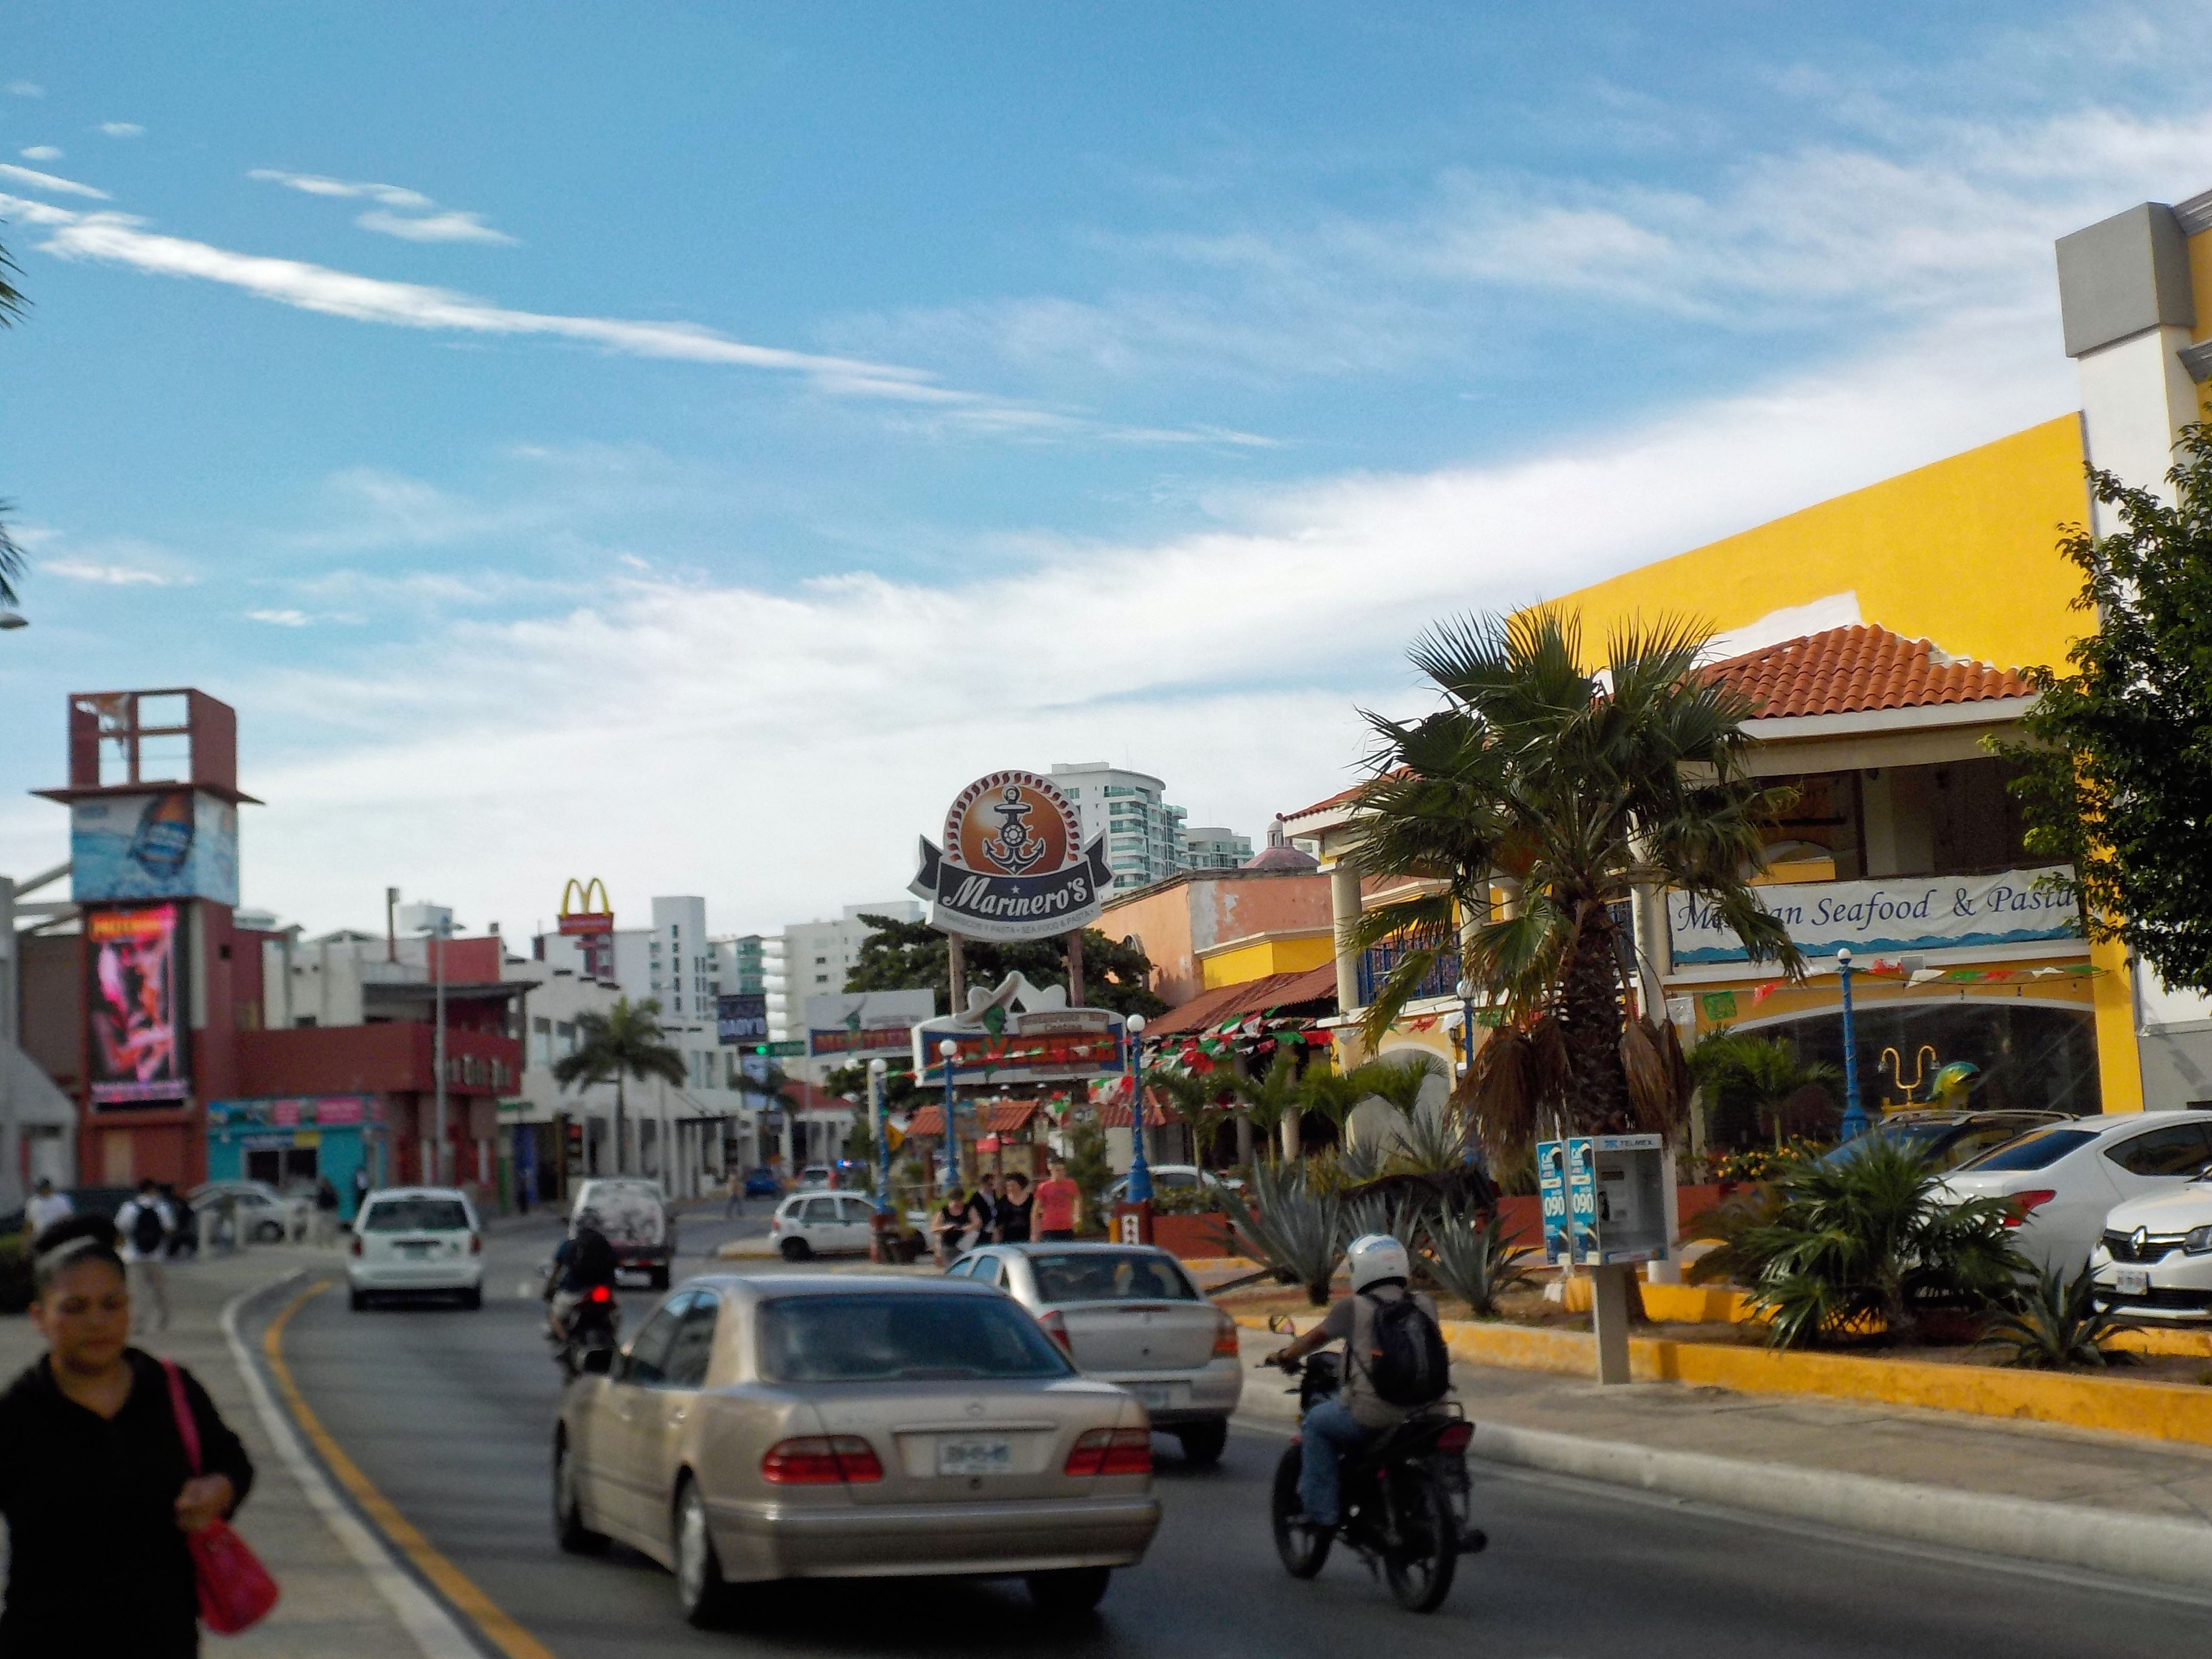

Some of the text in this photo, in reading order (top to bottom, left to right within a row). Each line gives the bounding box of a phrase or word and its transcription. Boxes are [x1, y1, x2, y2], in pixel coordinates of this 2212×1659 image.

[1811, 889, 1938, 931] Seafood
[1953, 887, 1976, 917] &
[1987, 886, 2074, 913] Pasta
[990, 925, 1015, 933] PASTA
[1037, 921, 1060, 932] FOOD
[1067, 910, 1090, 925] PASTA
[1544, 1195, 1565, 1217] 090
[1573, 1193, 1594, 1213] 090
